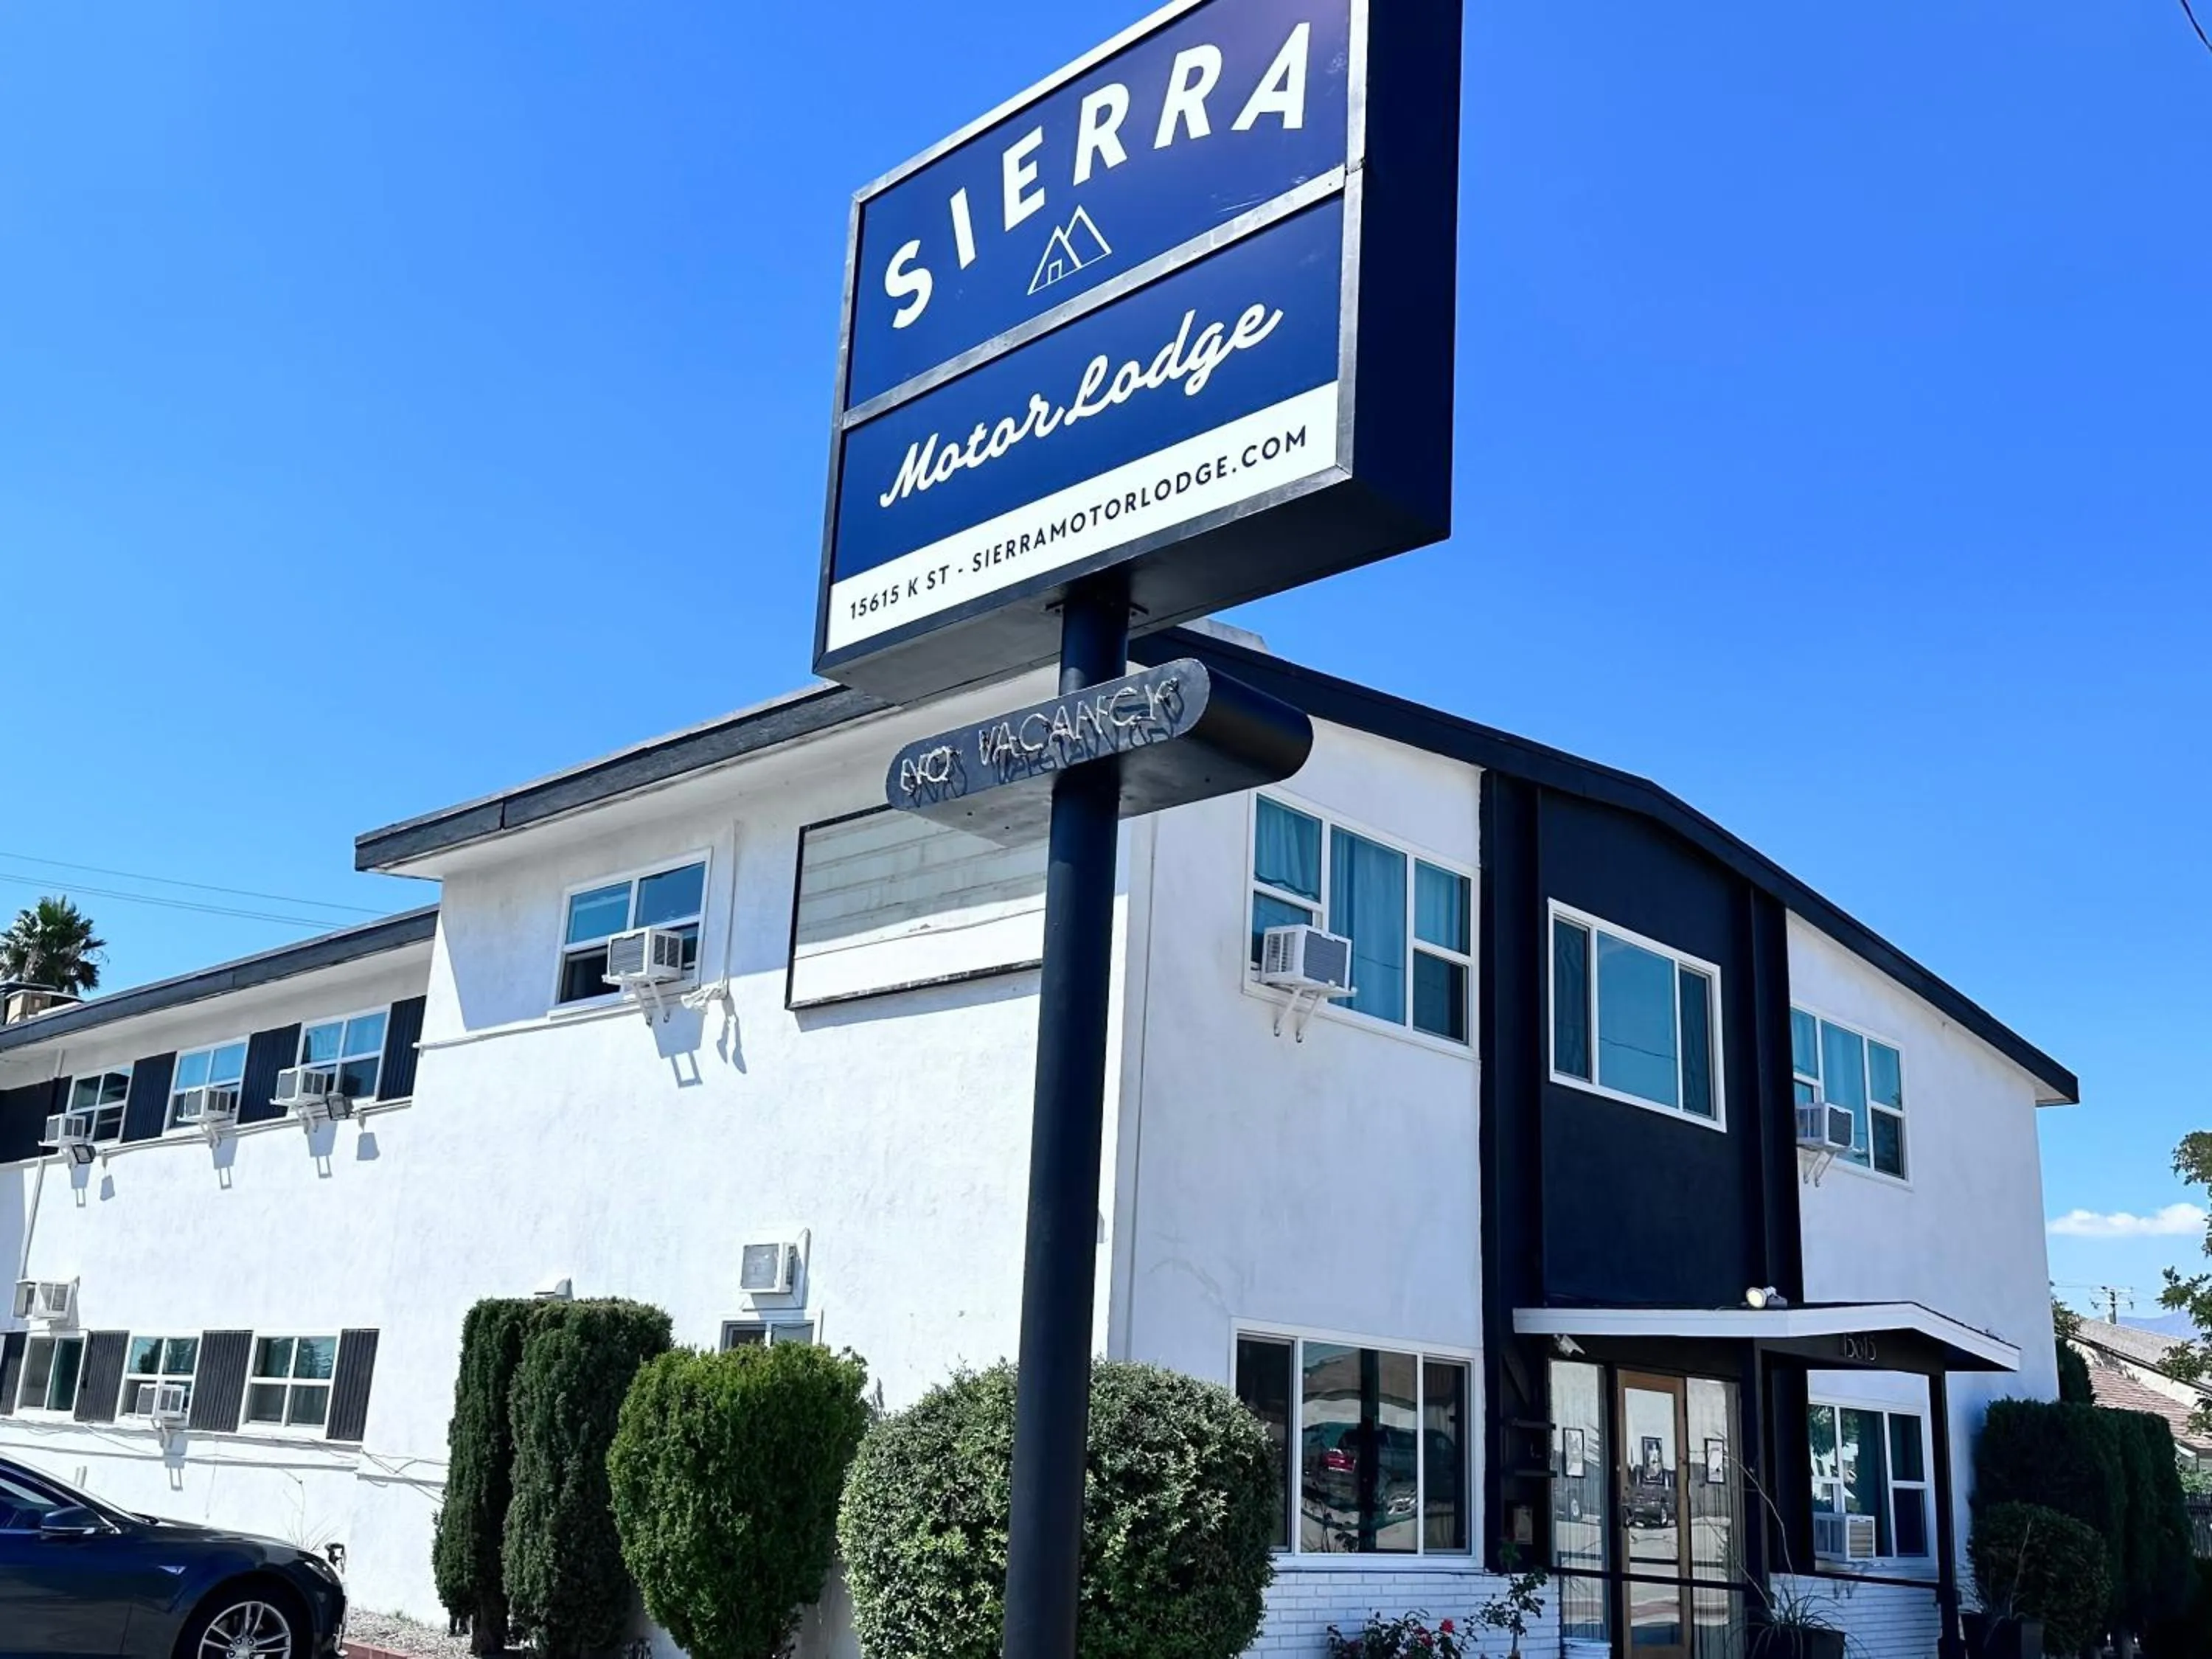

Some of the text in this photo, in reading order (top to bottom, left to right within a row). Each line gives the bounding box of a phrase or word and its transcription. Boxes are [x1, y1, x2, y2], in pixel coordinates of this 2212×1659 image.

[885, 21, 1310, 329] SIERRA
[880, 304, 1284, 508] Motor Lodge
[849, 585, 900, 620] 15615
[908, 577, 918, 597] K
[927, 565, 950, 590] ST
[972, 425, 1307, 573] SIERRAMOTORLODGE.COM
[899, 677, 1180, 790] NO VACANCY
